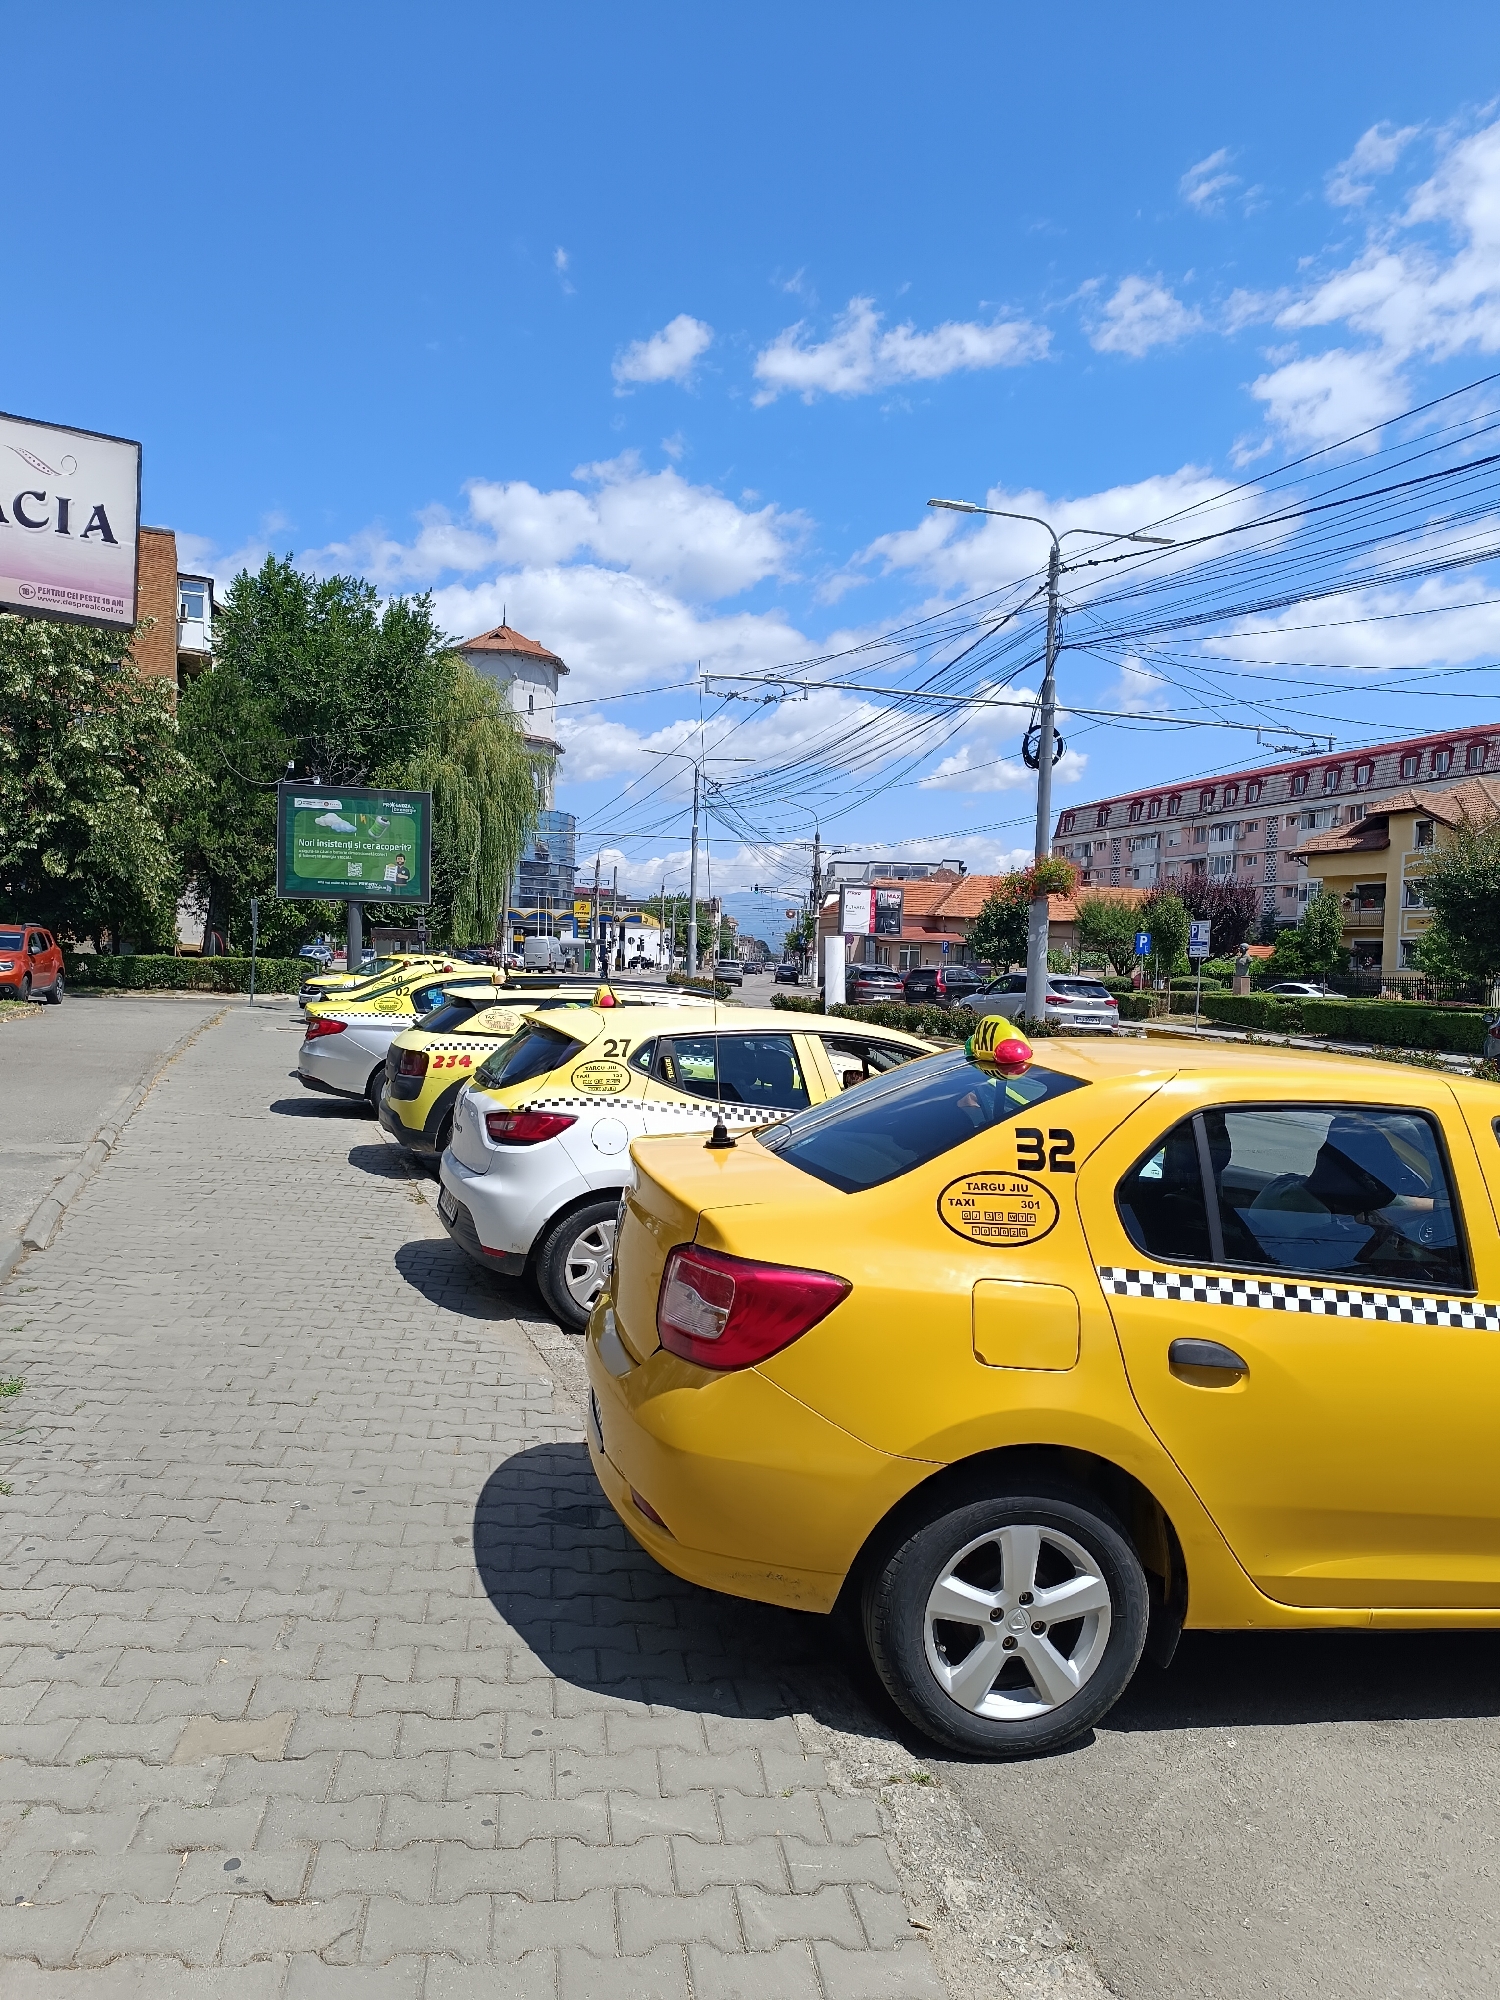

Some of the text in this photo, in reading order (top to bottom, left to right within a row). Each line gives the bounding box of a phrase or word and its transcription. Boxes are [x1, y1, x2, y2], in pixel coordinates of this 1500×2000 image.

[37, 586, 124, 608] PENTRU CEI PESTE 18 ANI
[37, 596, 124, 615] www.desprealcool.ro
[298, 839, 315, 847] Nori
[1139, 935, 1148, 948] P
[395, 986, 411, 997] 02
[603, 1038, 632, 1058] 27
[432, 1054, 473, 1069] 234
[1015, 1128, 1076, 1173] 32
[965, 1182, 1029, 1193] TARGU JIU
[947, 1198, 1041, 1210] TAXI 301
